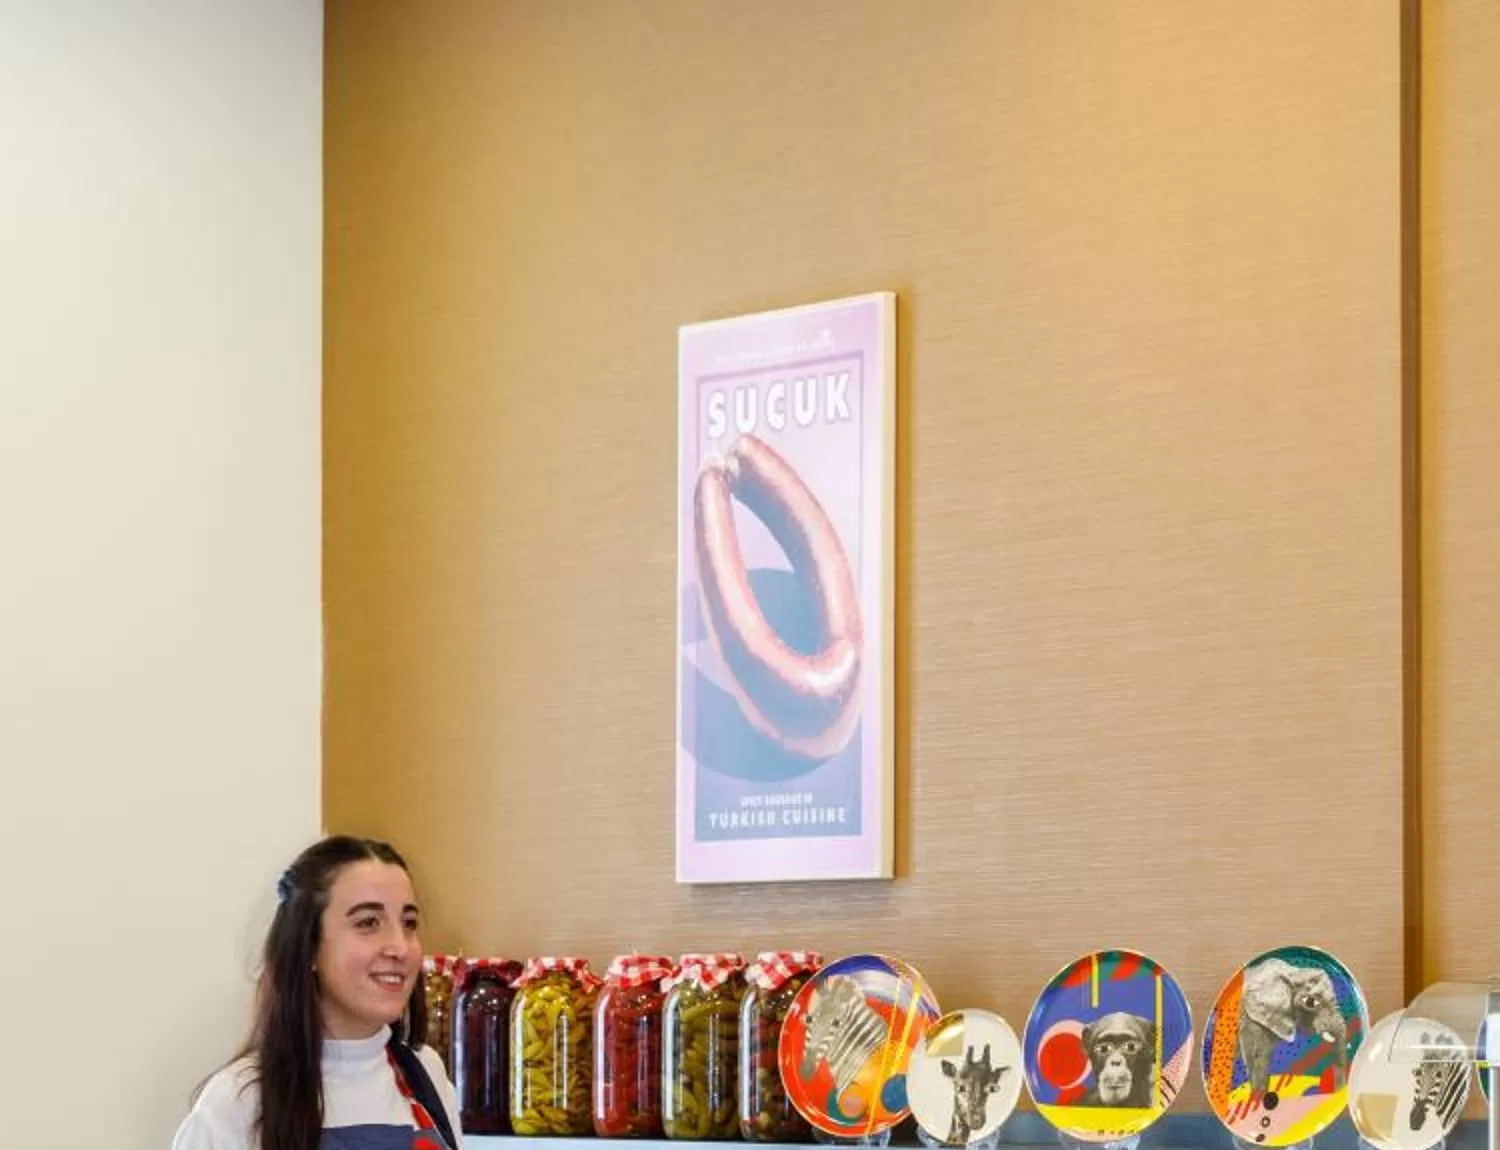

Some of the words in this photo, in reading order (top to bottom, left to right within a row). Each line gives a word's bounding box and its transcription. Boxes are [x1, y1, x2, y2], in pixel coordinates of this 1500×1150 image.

[707, 371, 851, 438] SUCUK
[708, 809, 776, 829] TURKISH
[782, 807, 847, 825] CUISINE
